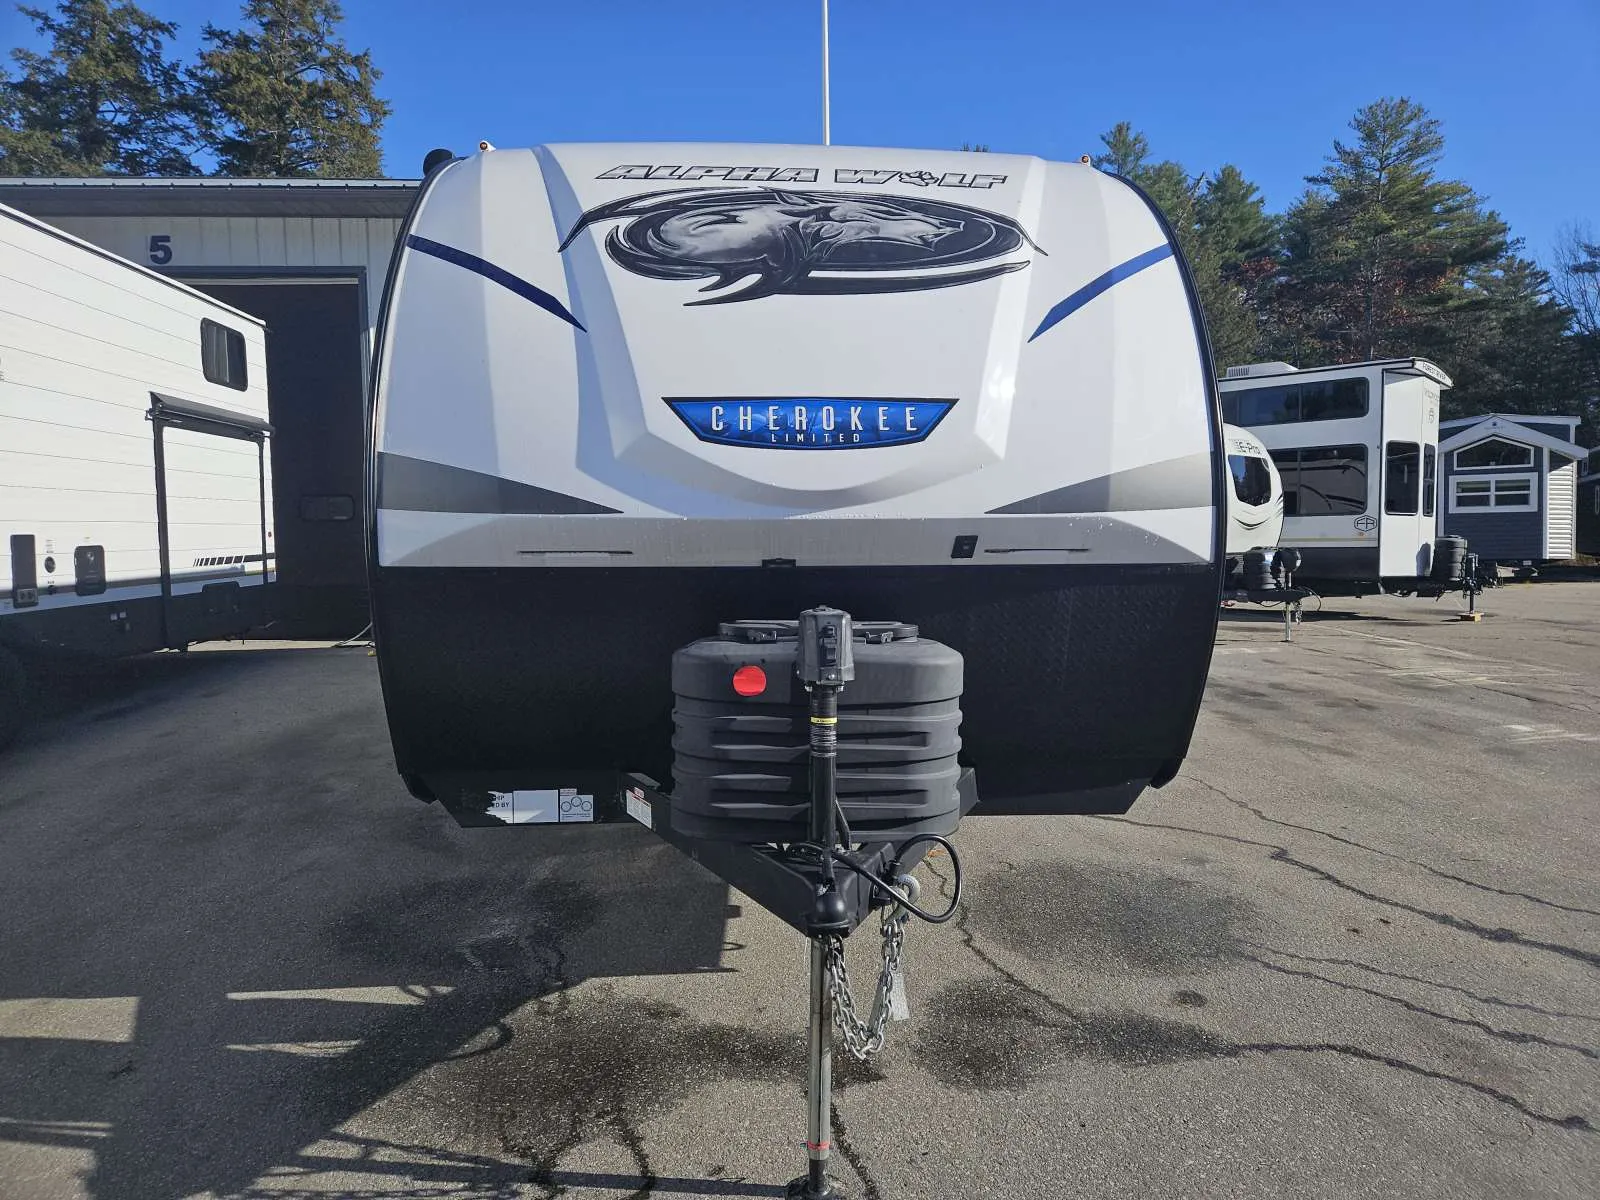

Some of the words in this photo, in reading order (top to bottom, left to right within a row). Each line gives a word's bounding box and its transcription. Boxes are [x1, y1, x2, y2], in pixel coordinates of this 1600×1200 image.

[595, 164, 819, 182] ALPHA
[149, 235, 173, 266] 5
[711, 404, 918, 432] CHEROKEE
[771, 432, 861, 444] LIMITED
